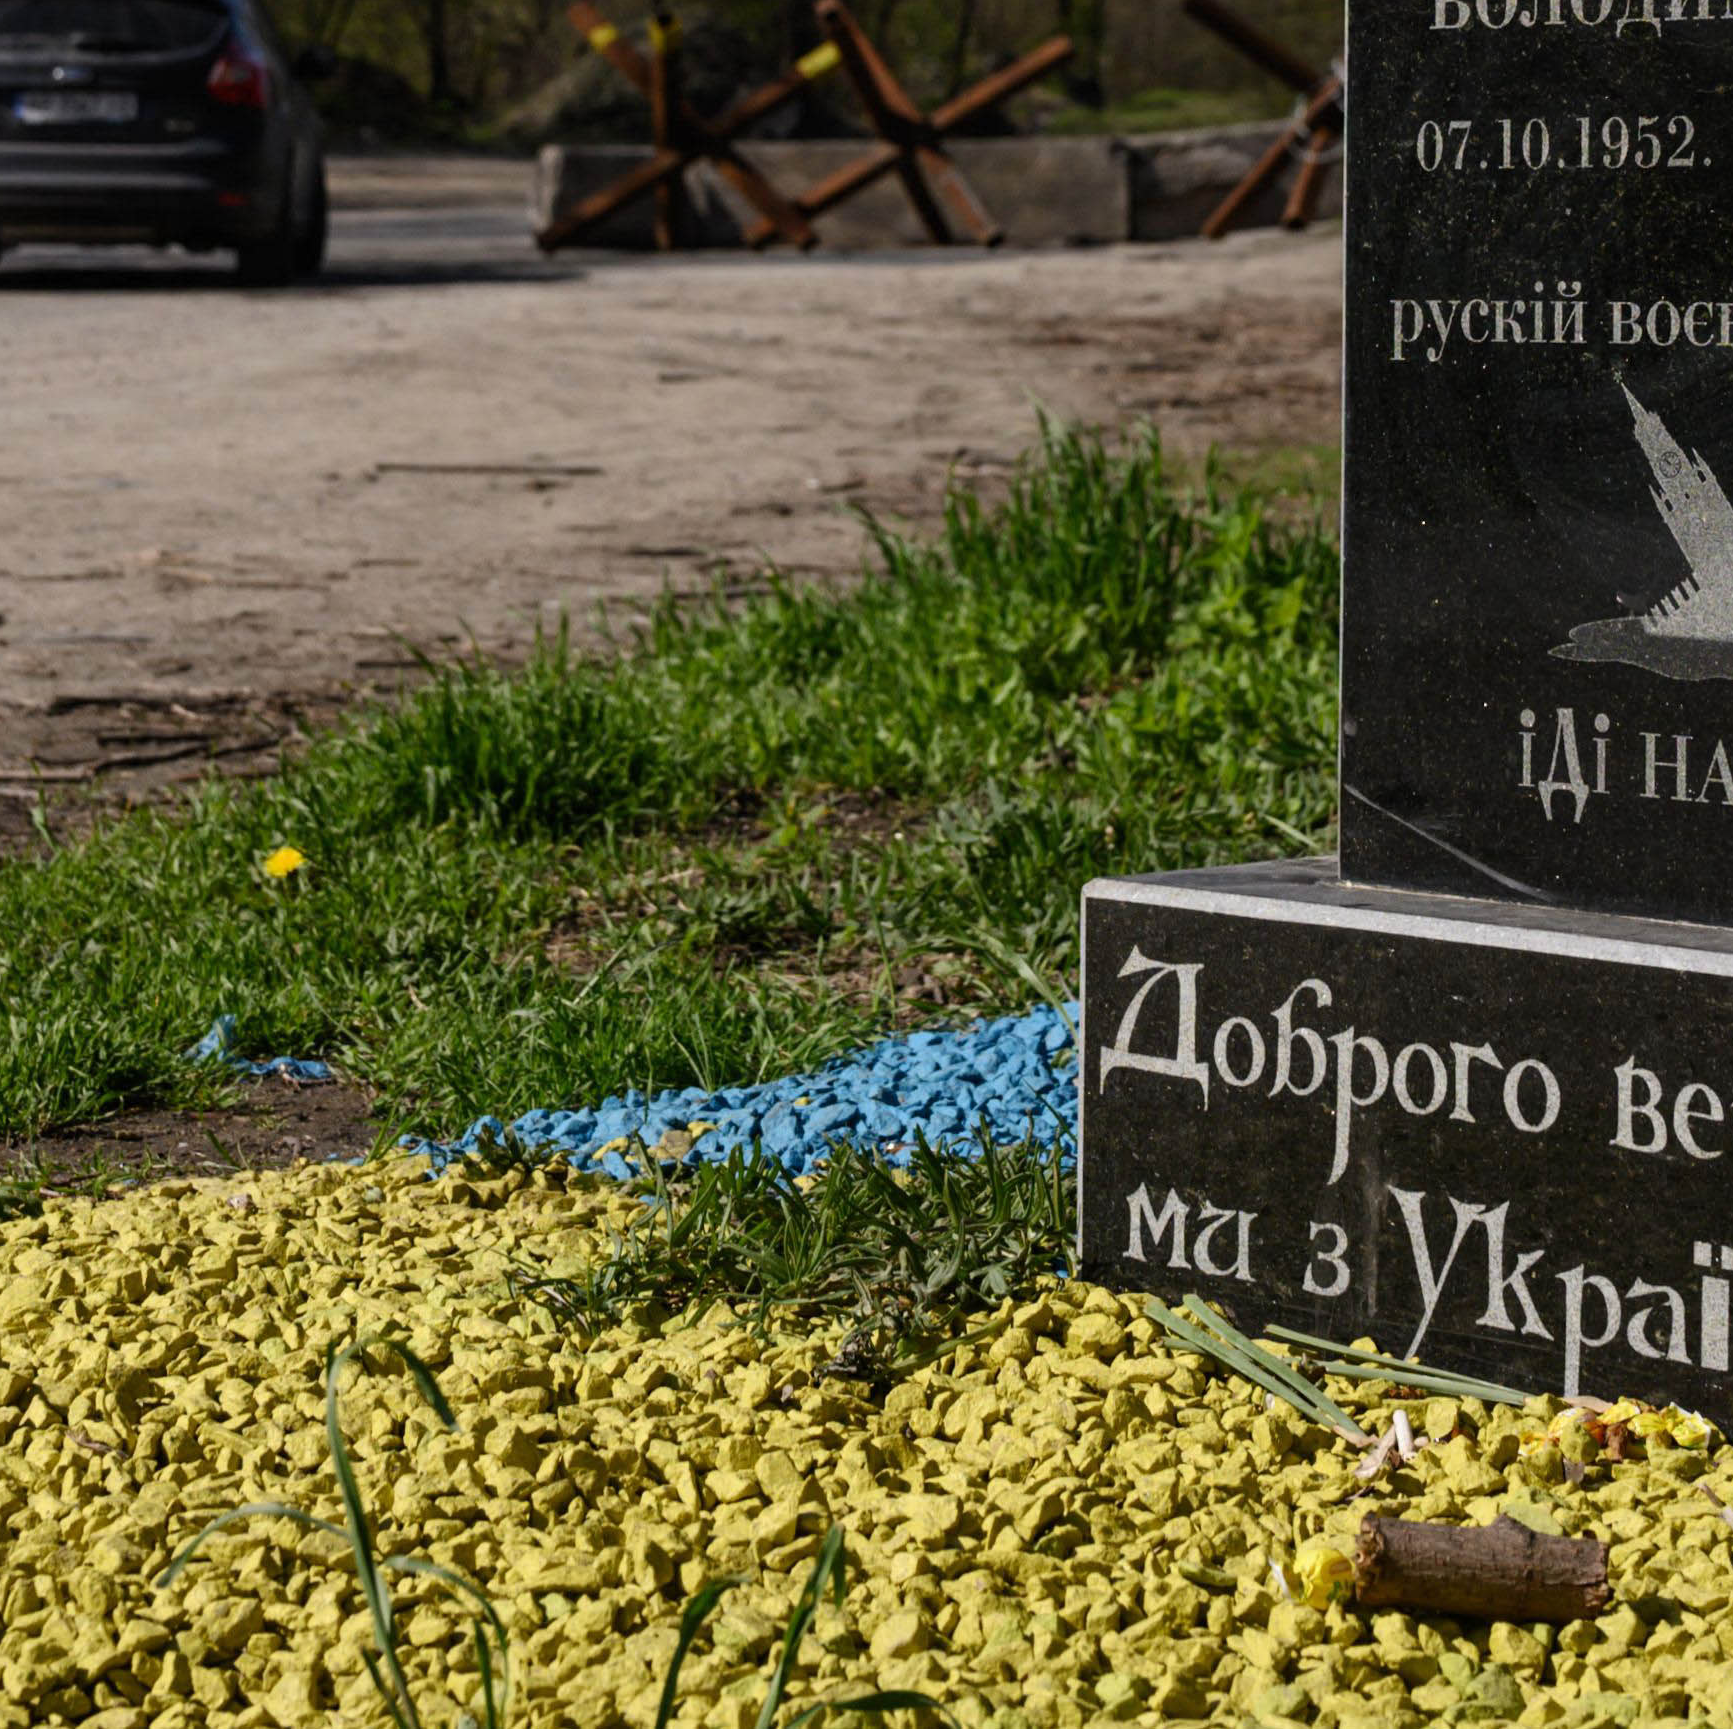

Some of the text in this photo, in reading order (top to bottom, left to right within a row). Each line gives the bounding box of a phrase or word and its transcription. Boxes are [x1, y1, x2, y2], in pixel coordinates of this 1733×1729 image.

[1416, 115, 1712, 171] 07.10.1952.
[1389, 280, 1587, 363] рускій
[1099, 944, 1561, 1185] Доброго
[1123, 1186, 1257, 1283] ми
[1303, 1222, 1352, 1298] з
